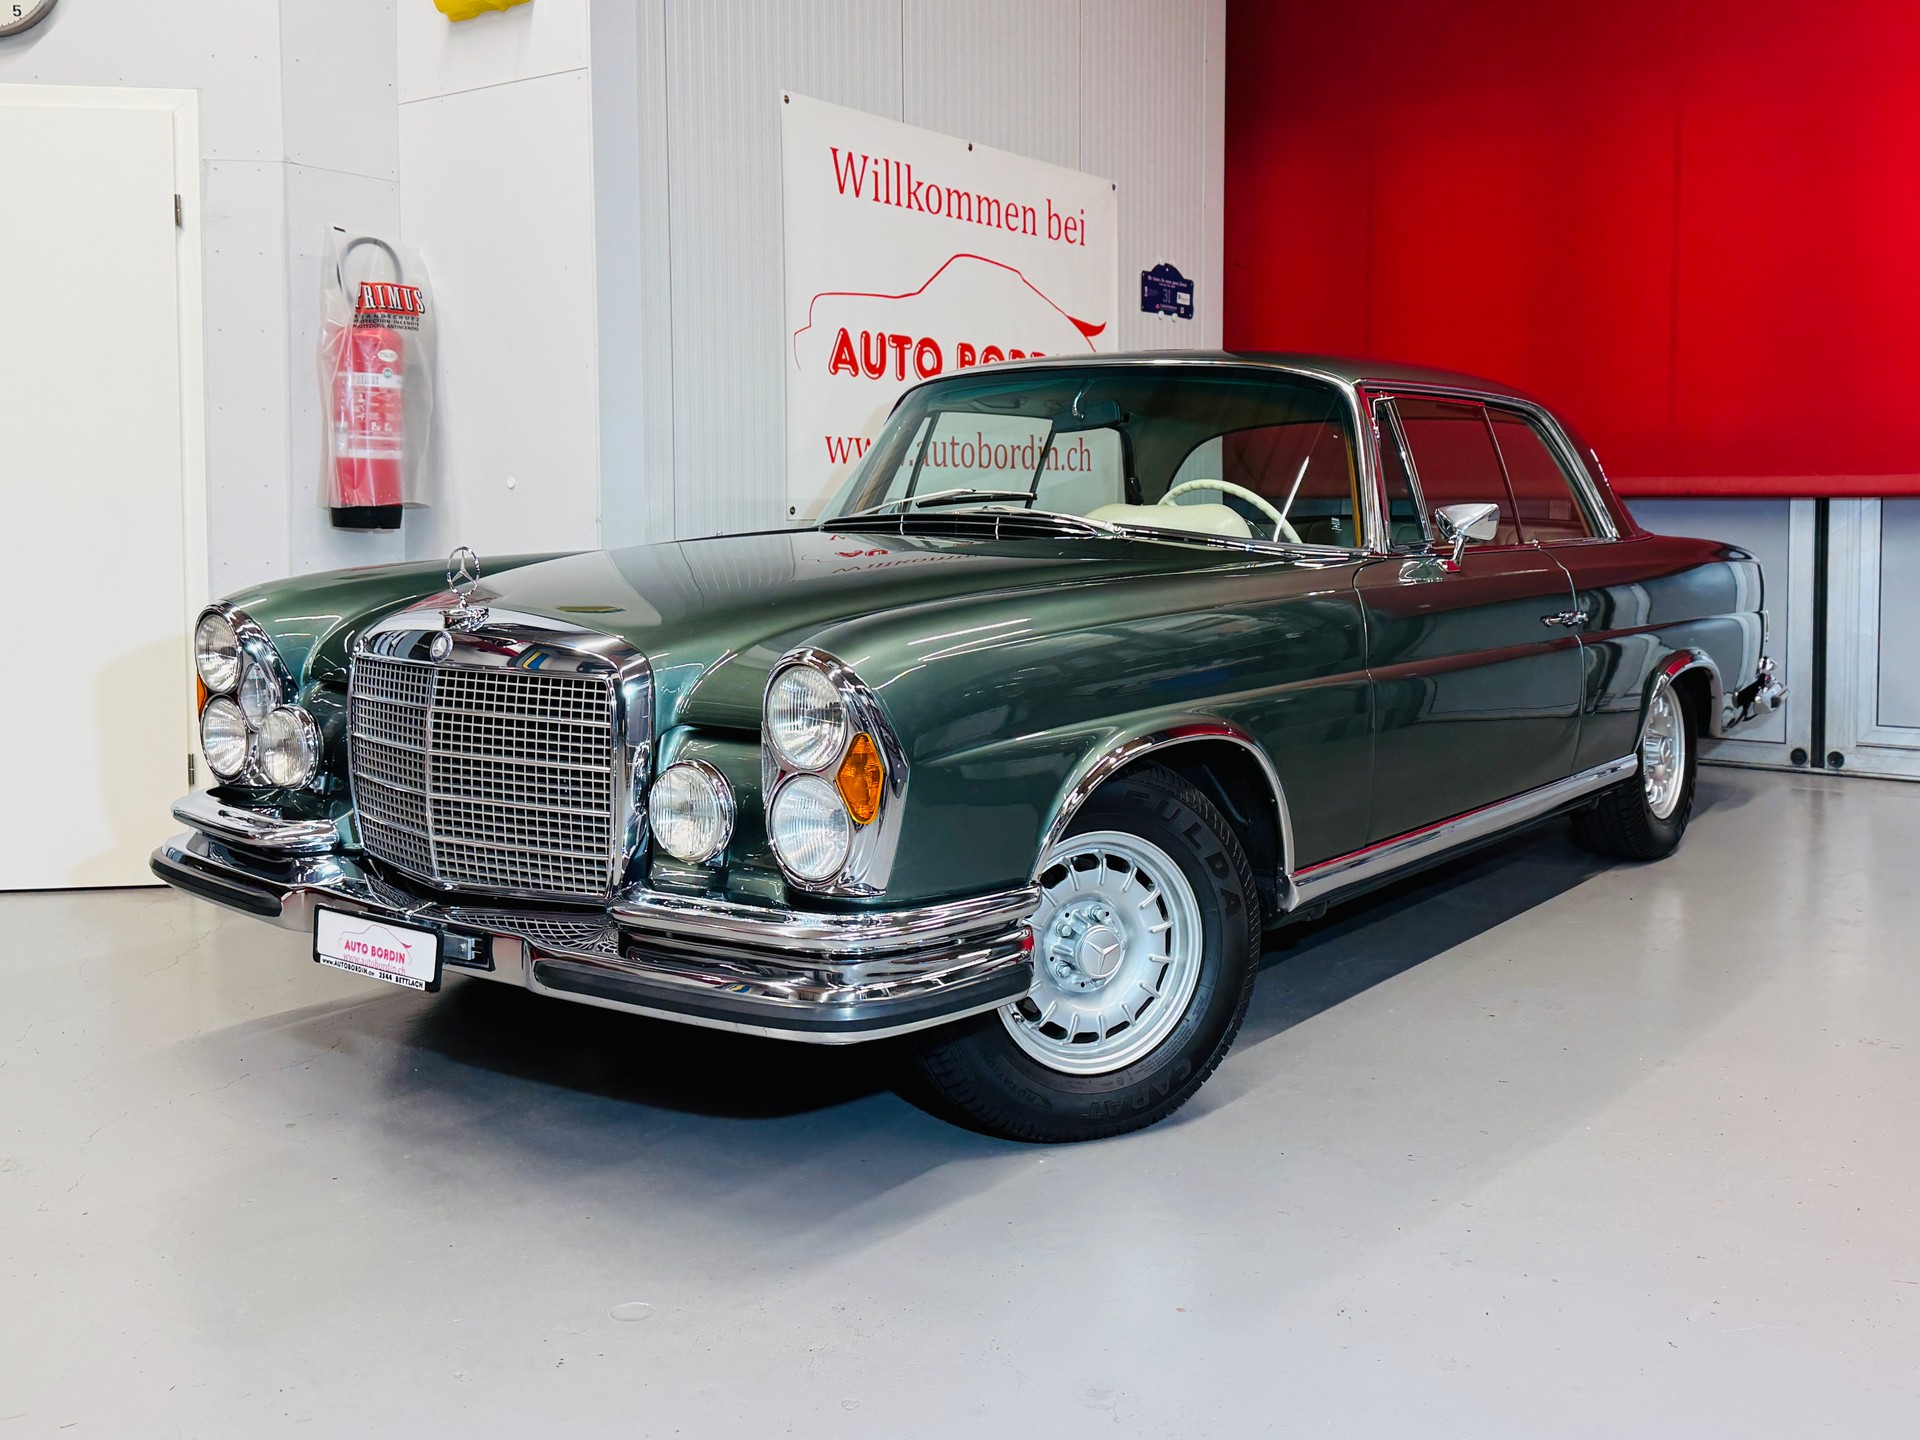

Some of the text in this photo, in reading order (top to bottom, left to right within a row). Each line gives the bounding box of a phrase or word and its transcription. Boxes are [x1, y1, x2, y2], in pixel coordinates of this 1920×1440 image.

[12, 4, 22, 17] 5
[829, 146, 1086, 246] Willkommen bei
[1162, 288, 1171, 303] 31
[828, 327, 943, 382] AUTO
[1124, 789, 1242, 918] FULDA
[344, 939, 406, 964] AUTO BORDIN
[378, 972, 393, 981] 2544
[395, 975, 424, 989] BETTLACH
